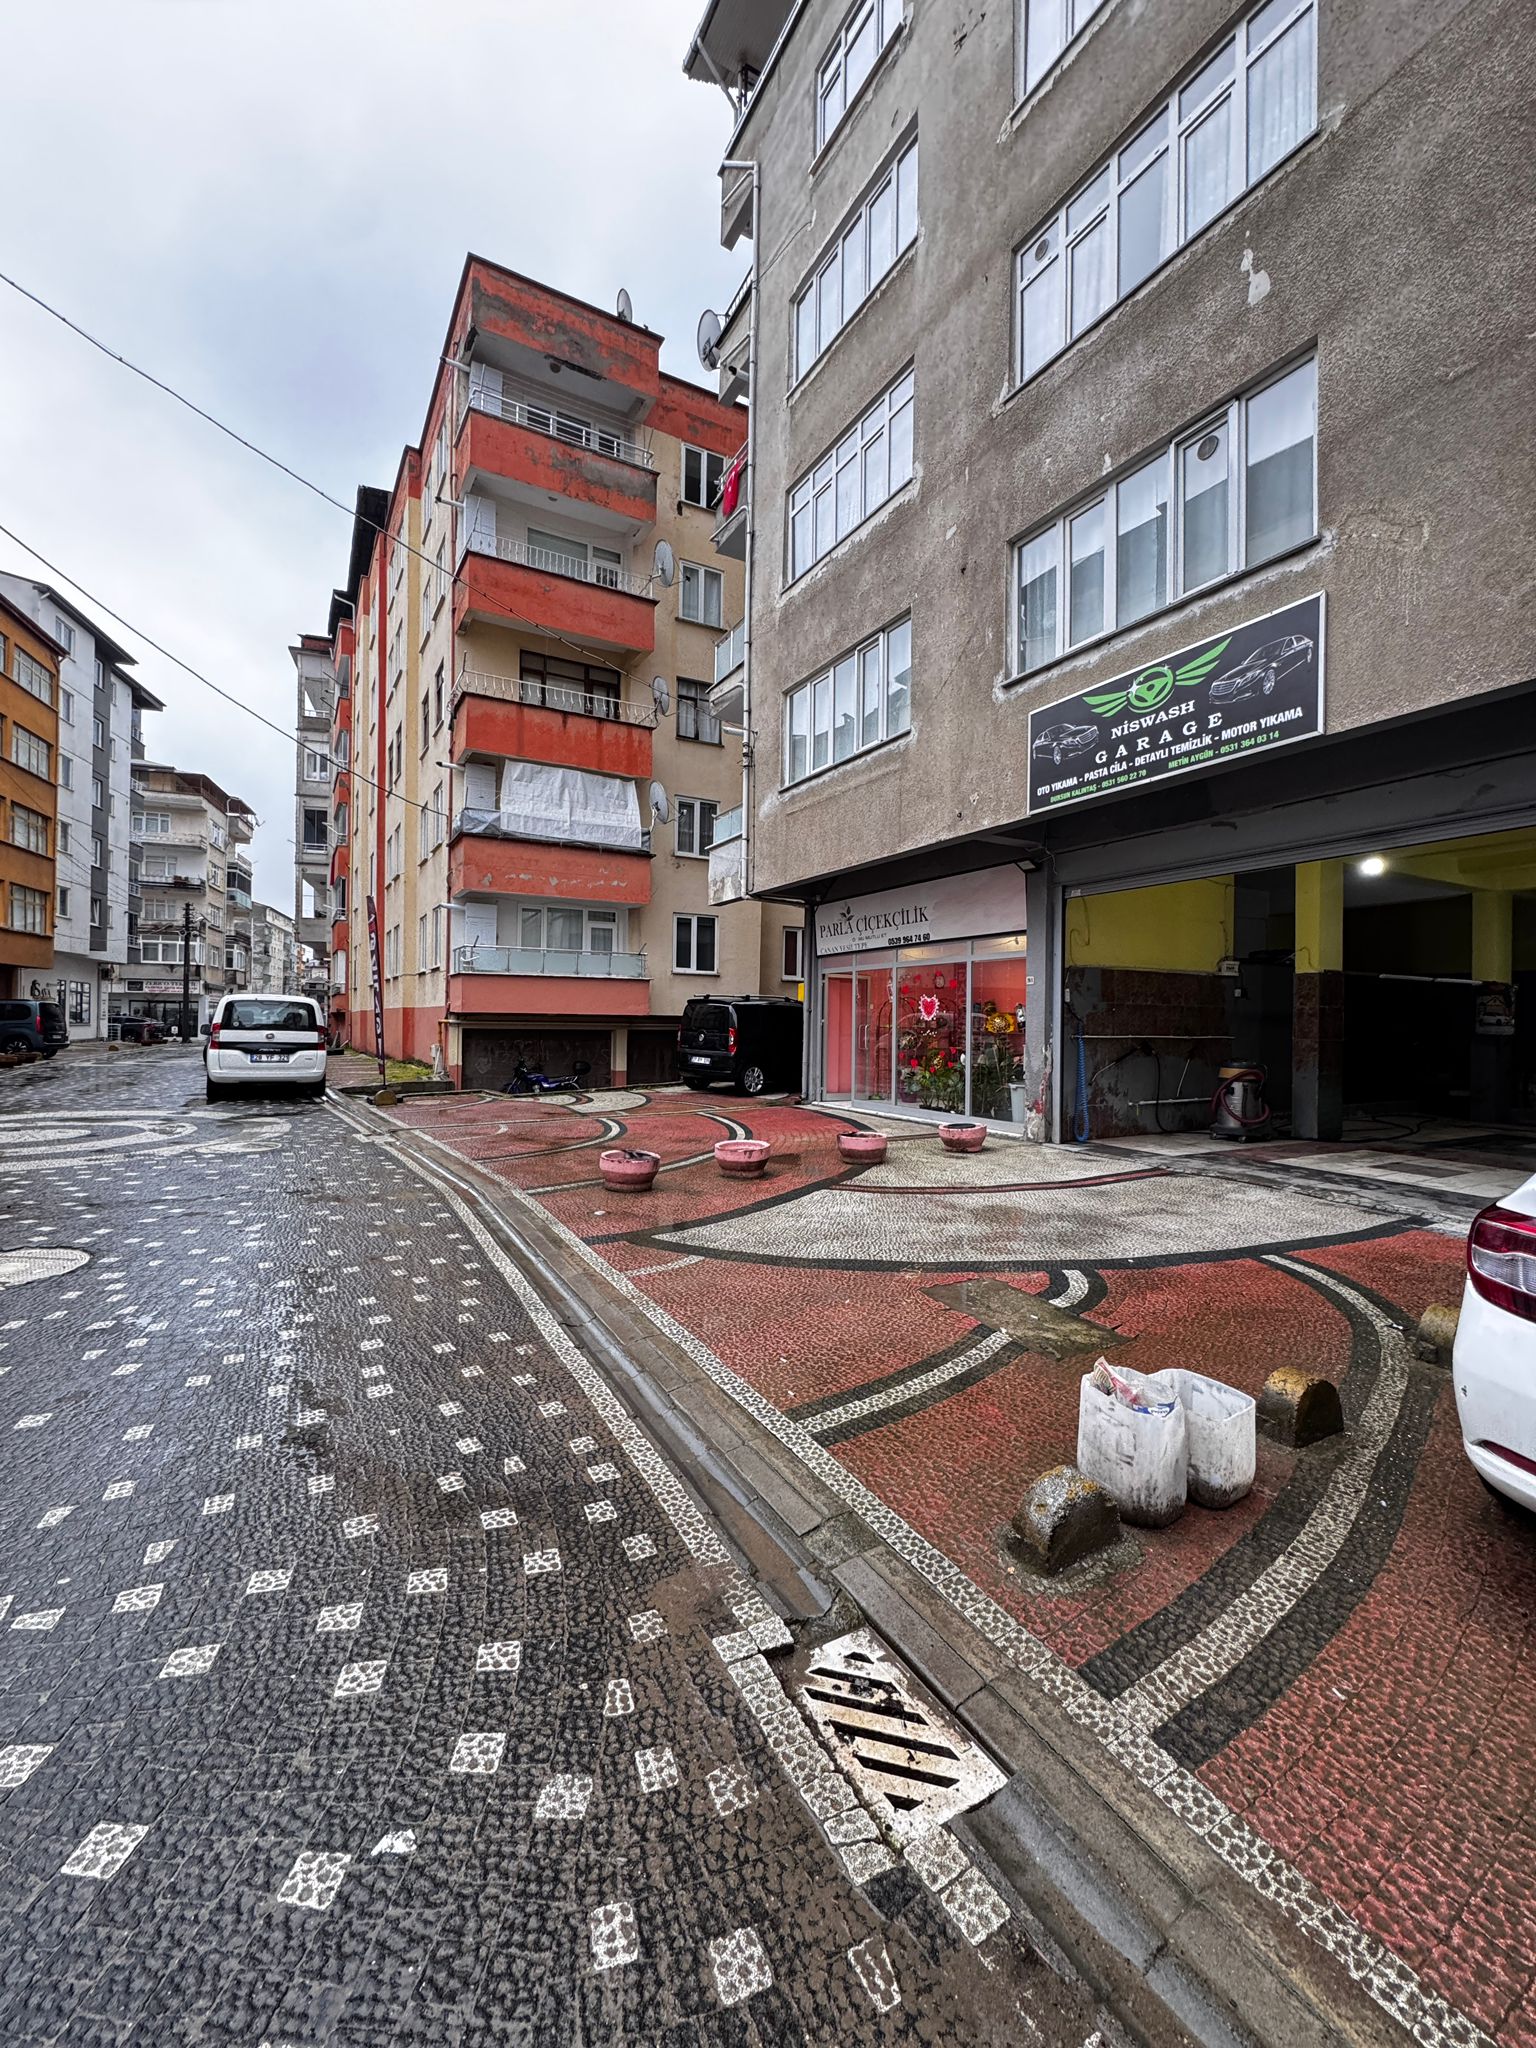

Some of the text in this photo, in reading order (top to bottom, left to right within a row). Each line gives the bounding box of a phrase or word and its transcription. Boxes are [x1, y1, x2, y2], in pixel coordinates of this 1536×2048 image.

[1111, 700, 1196, 739] NİSWASH
[1037, 784, 1050, 796] OTO
[1051, 776, 1078, 792] YIKAMA
[1084, 766, 1109, 782] PASTA
[1109, 761, 1127, 775] CİLA
[1135, 747, 1169, 767] DETAYLI
[1170, 733, 1213, 756] TEMİZLİK
[1221, 720, 1257, 741] MOTOR
[1259, 706, 1303, 729] YIKAMA
[1095, 712, 1223, 764] GARAGE
[1220, 742, 1238, 754] 0531
[1256, 733, 1267, 744] 03
[1269, 730, 1280, 740] 14
[1101, 778, 1116, 789] 0531
[820, 905, 929, 938] PARLA ÇİÇEKÇİLİK
